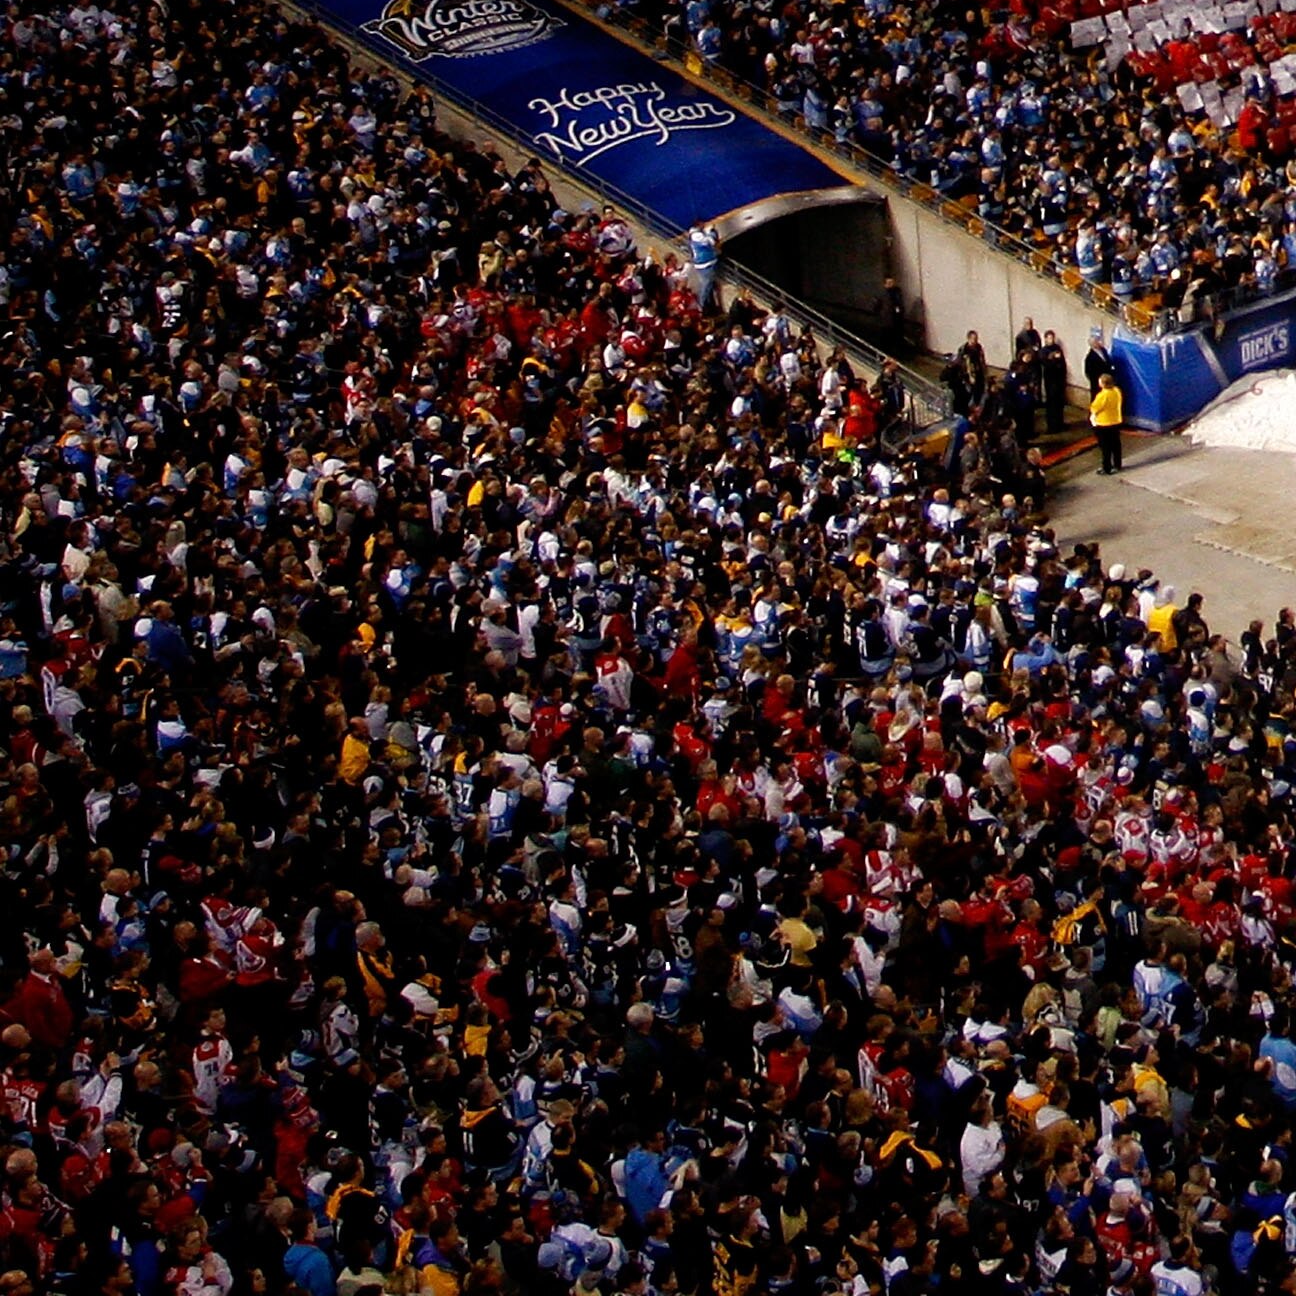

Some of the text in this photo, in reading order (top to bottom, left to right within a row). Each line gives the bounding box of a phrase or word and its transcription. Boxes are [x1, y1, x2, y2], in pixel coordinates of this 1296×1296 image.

[427, 12, 523, 43] CLASSIC
[527, 81, 666, 128] Happy
[1241, 326, 1289, 365] DICK'S
[462, 1131, 474, 1155] 11
